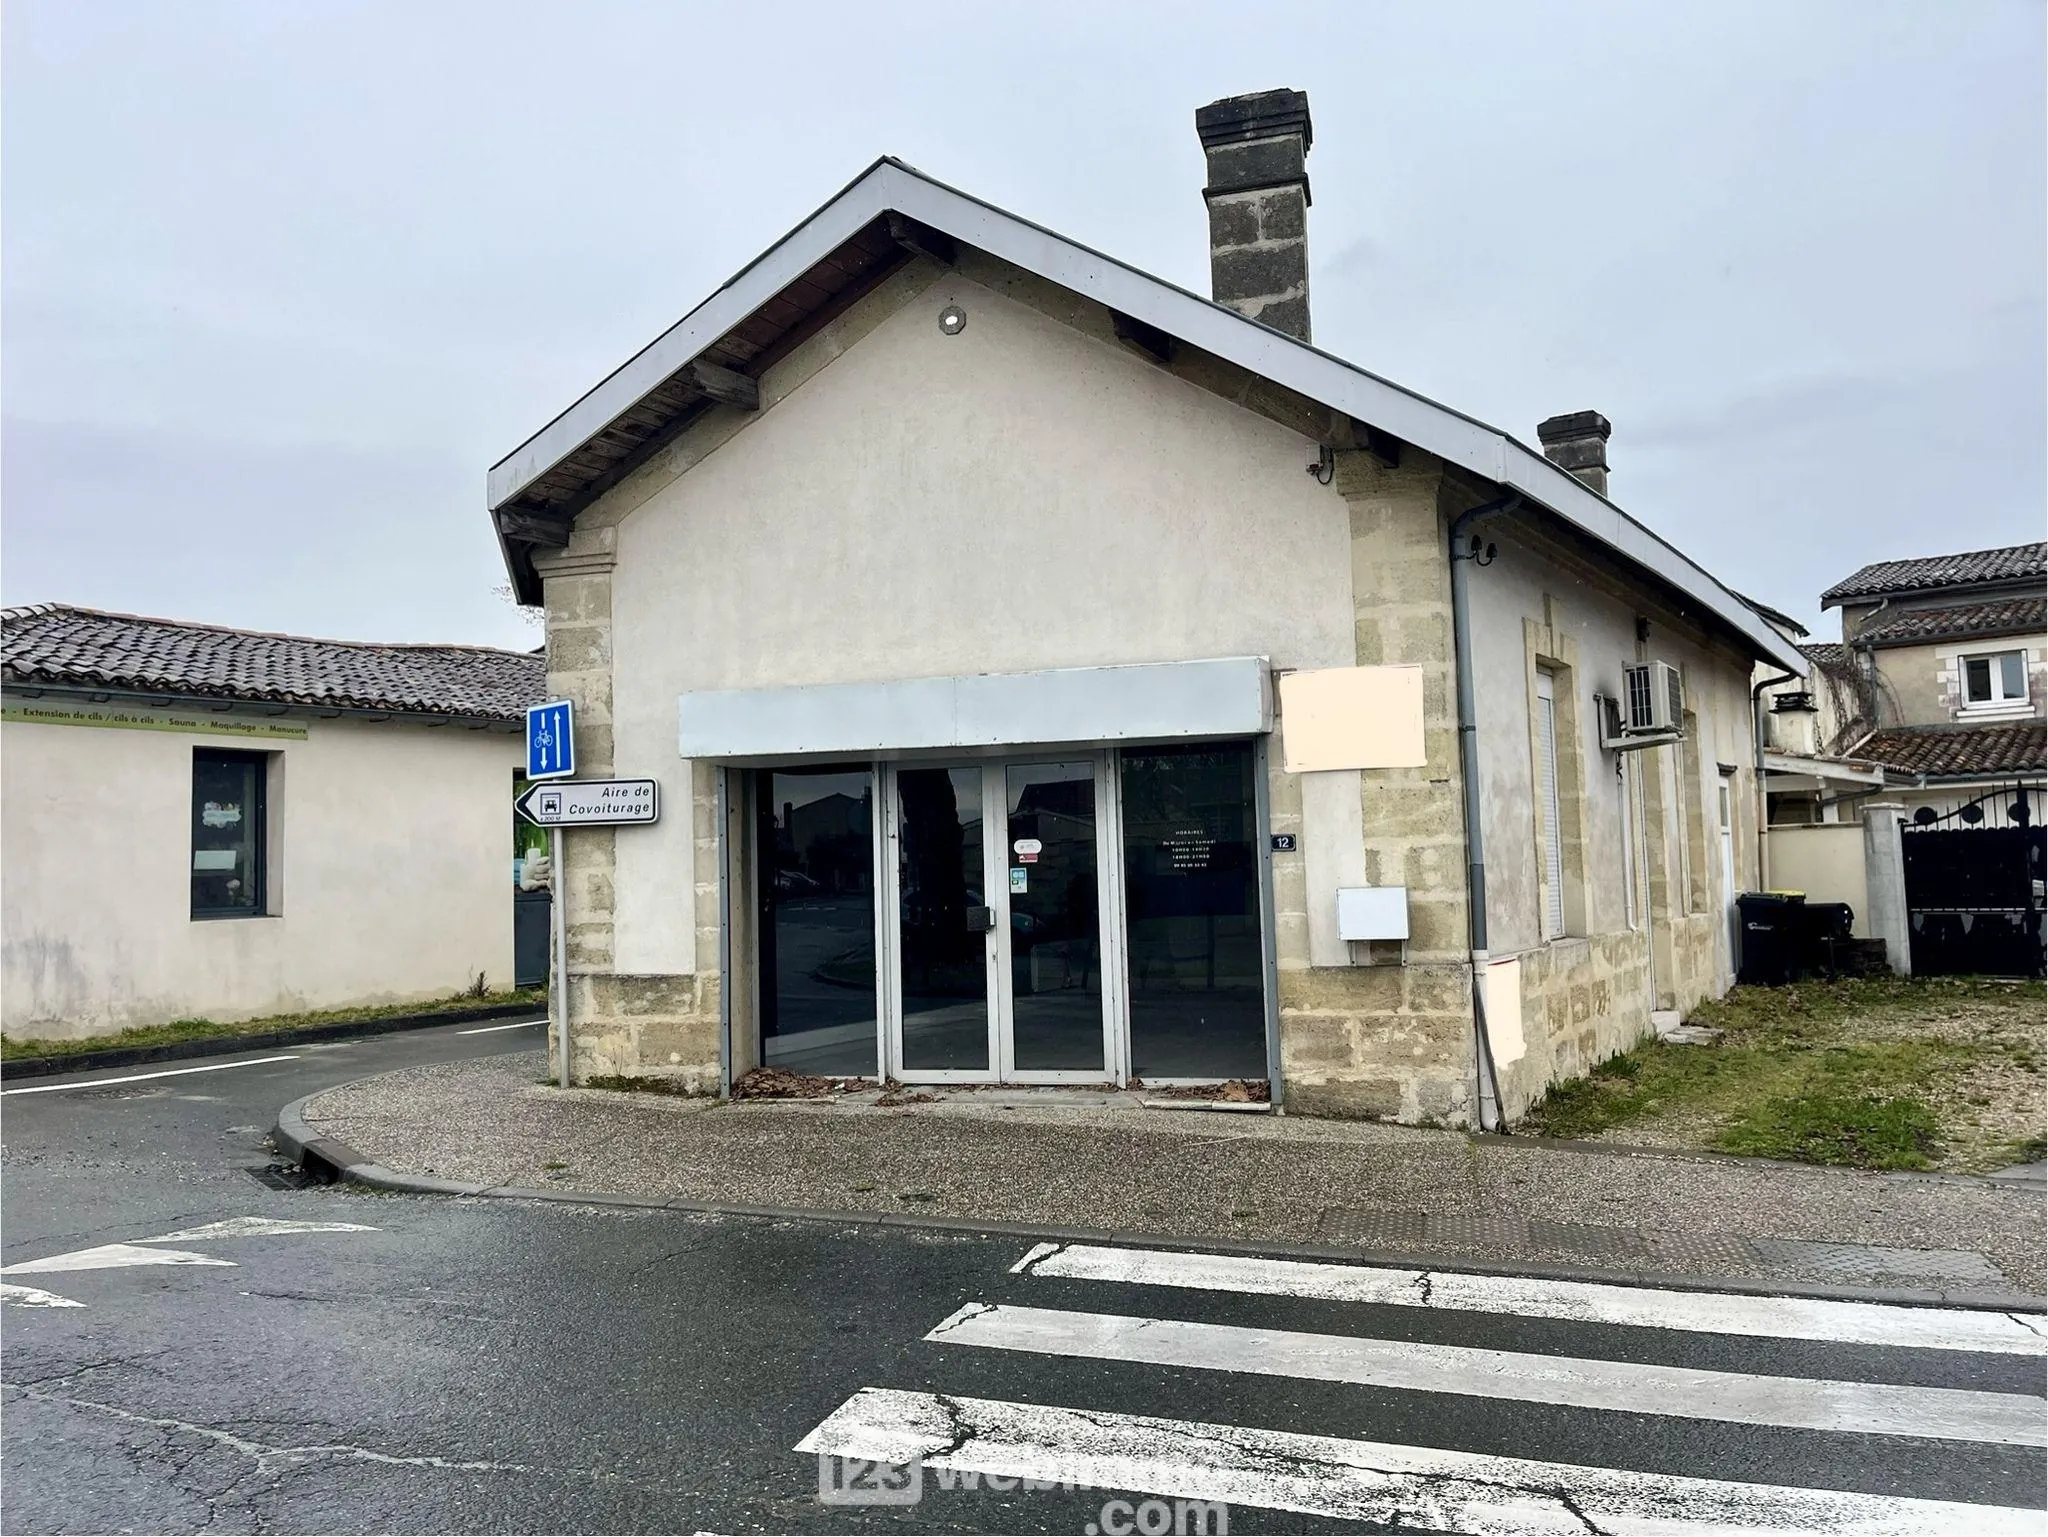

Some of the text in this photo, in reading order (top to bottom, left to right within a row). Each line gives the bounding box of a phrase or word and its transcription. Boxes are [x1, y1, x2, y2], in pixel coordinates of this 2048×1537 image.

[23, 707, 71, 719] Extension
[73, 711, 85, 720] de
[88, 712, 103, 721] cils
[114, 713, 128, 722] cils
[140, 715, 154, 725] cils
[168, 718, 197, 727] Sauna
[210, 721, 257, 733] Maquillage
[269, 725, 307, 735] Manucure
[602, 786, 650, 798] Aire de
[569, 802, 650, 815] Covoiturage
[1277, 836, 1290, 848] 12
